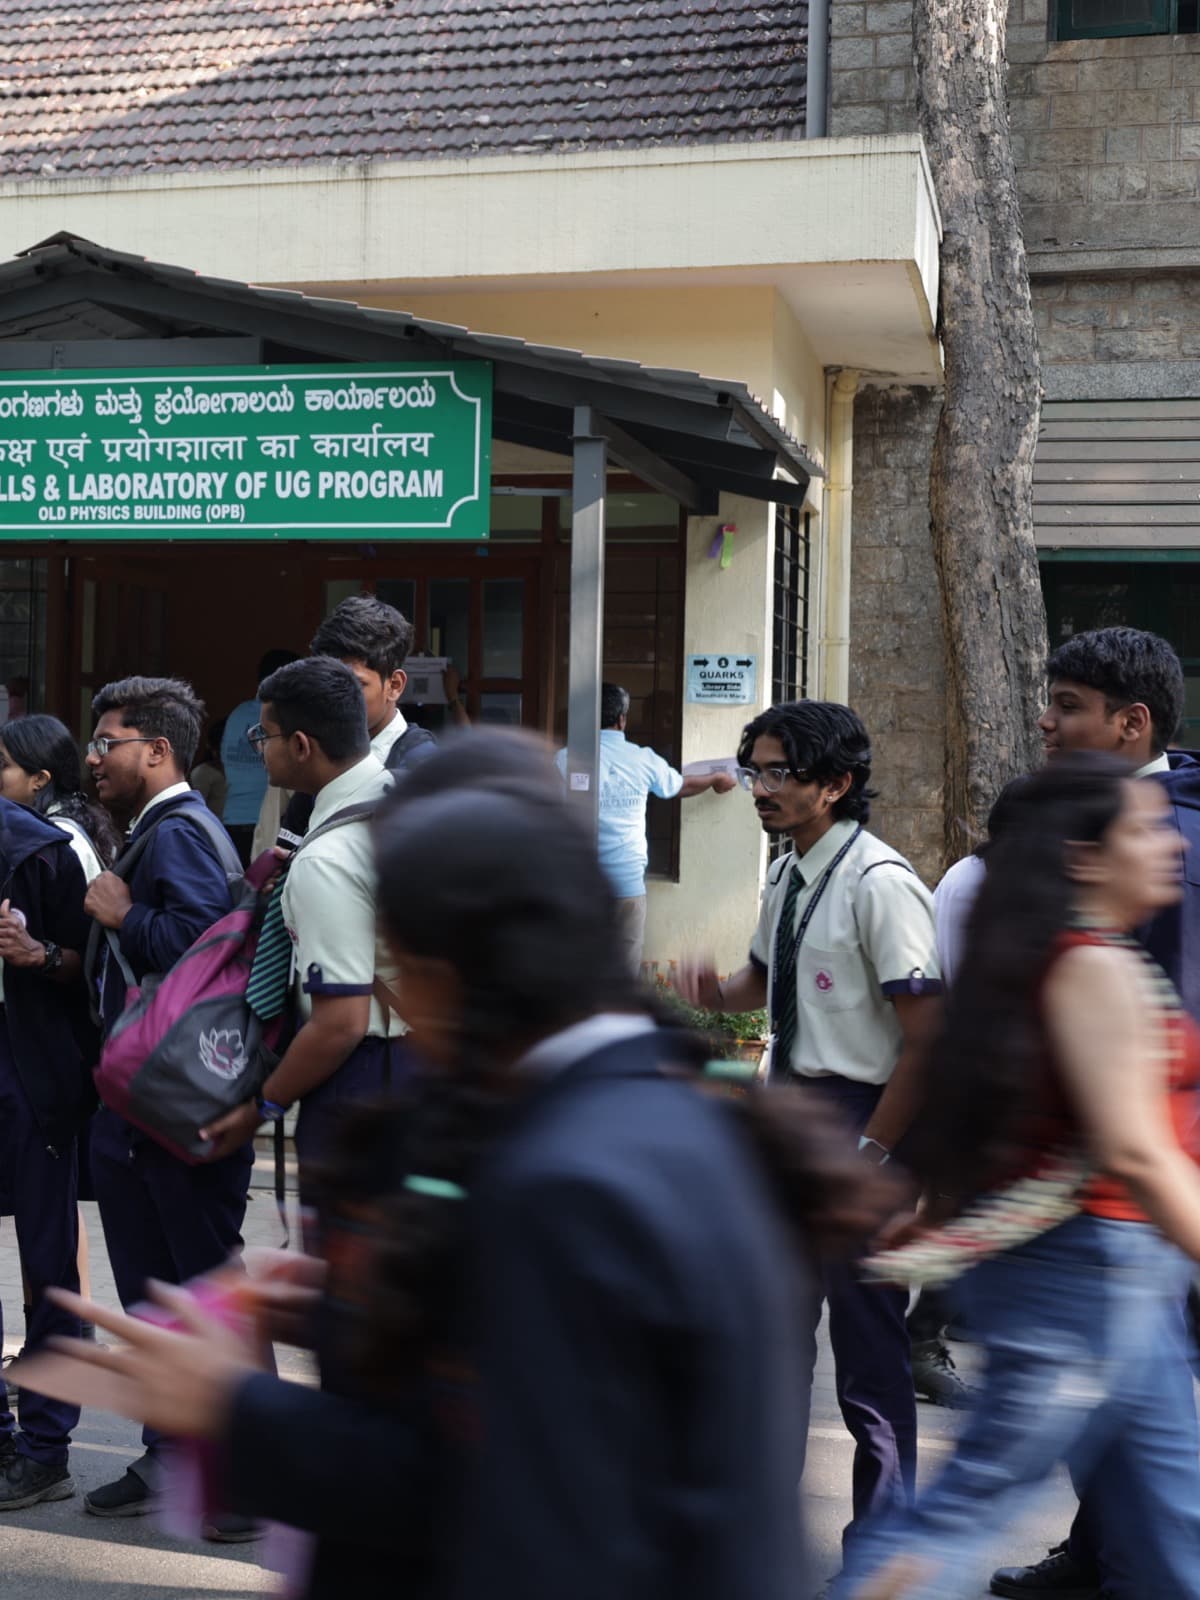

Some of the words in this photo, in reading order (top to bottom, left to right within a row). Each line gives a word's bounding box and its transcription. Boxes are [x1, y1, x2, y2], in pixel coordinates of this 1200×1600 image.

[95, 386, 142, 424] ಮತ್ತು
[154, 383, 295, 425] ಪ್ರಯೋಗಾಲಯ
[304, 378, 436, 411] ಕಾರ್ಯಾಲಯ
[46, 432, 91, 468] एवं
[101, 429, 247, 462] प्रयोगशाला
[257, 435, 300, 458] का
[310, 423, 434, 457] कार्यालय
[44, 475, 60, 501] &
[69, 472, 228, 500] LABORATORY
[235, 472, 267, 499] OF
[276, 471, 310, 498] UG
[319, 470, 443, 498] PROGRAM
[39, 506, 66, 520] OLD
[70, 506, 130, 520] PHYSICS
[134, 505, 202, 519] BUILDING
[206, 504, 245, 522] (OPB)
[699, 671, 744, 680] QUARKS
